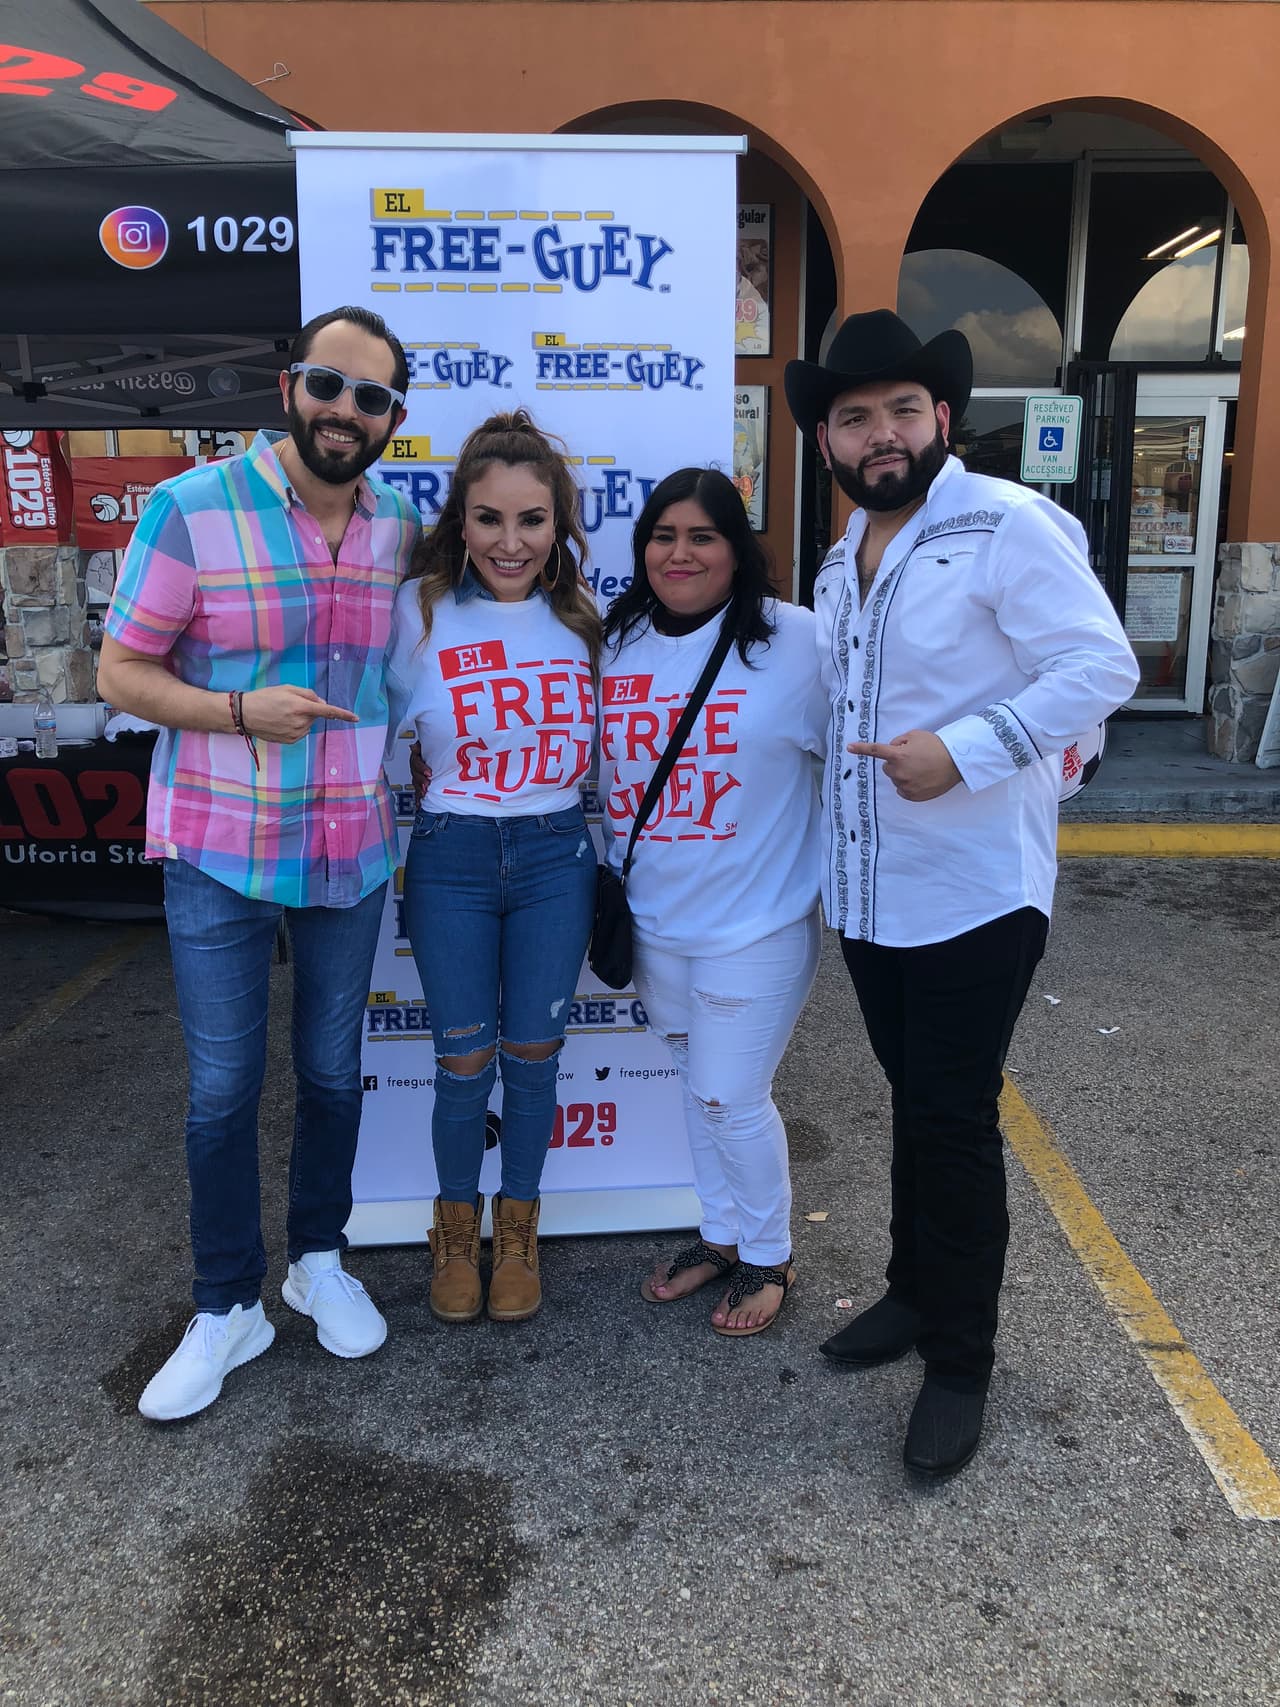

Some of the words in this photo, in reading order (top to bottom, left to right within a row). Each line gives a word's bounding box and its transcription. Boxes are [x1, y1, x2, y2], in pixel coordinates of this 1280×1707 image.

[384, 193, 411, 213] EL
[187, 216, 294, 252] 1029
[371, 225, 674, 291] FREE-GUEY
[544, 334, 560, 346] EL
[536, 350, 705, 389] FREE-GUEY
[1033, 403, 1074, 413] RESERVED
[1035, 415, 1071, 424] PARKING
[391, 440, 418, 458] EL
[1042, 455, 1058, 463] VAN
[1025, 465, 1073, 475] ACCESSIBLE
[46, 496, 57, 526] Latino
[455, 646, 493, 673] EL
[611, 678, 639, 702] EL
[448, 672, 595, 738] FREE
[601, 702, 739, 761] FREE
[5, 843, 96, 864] Uforia
[375, 993, 390, 1003] EL
